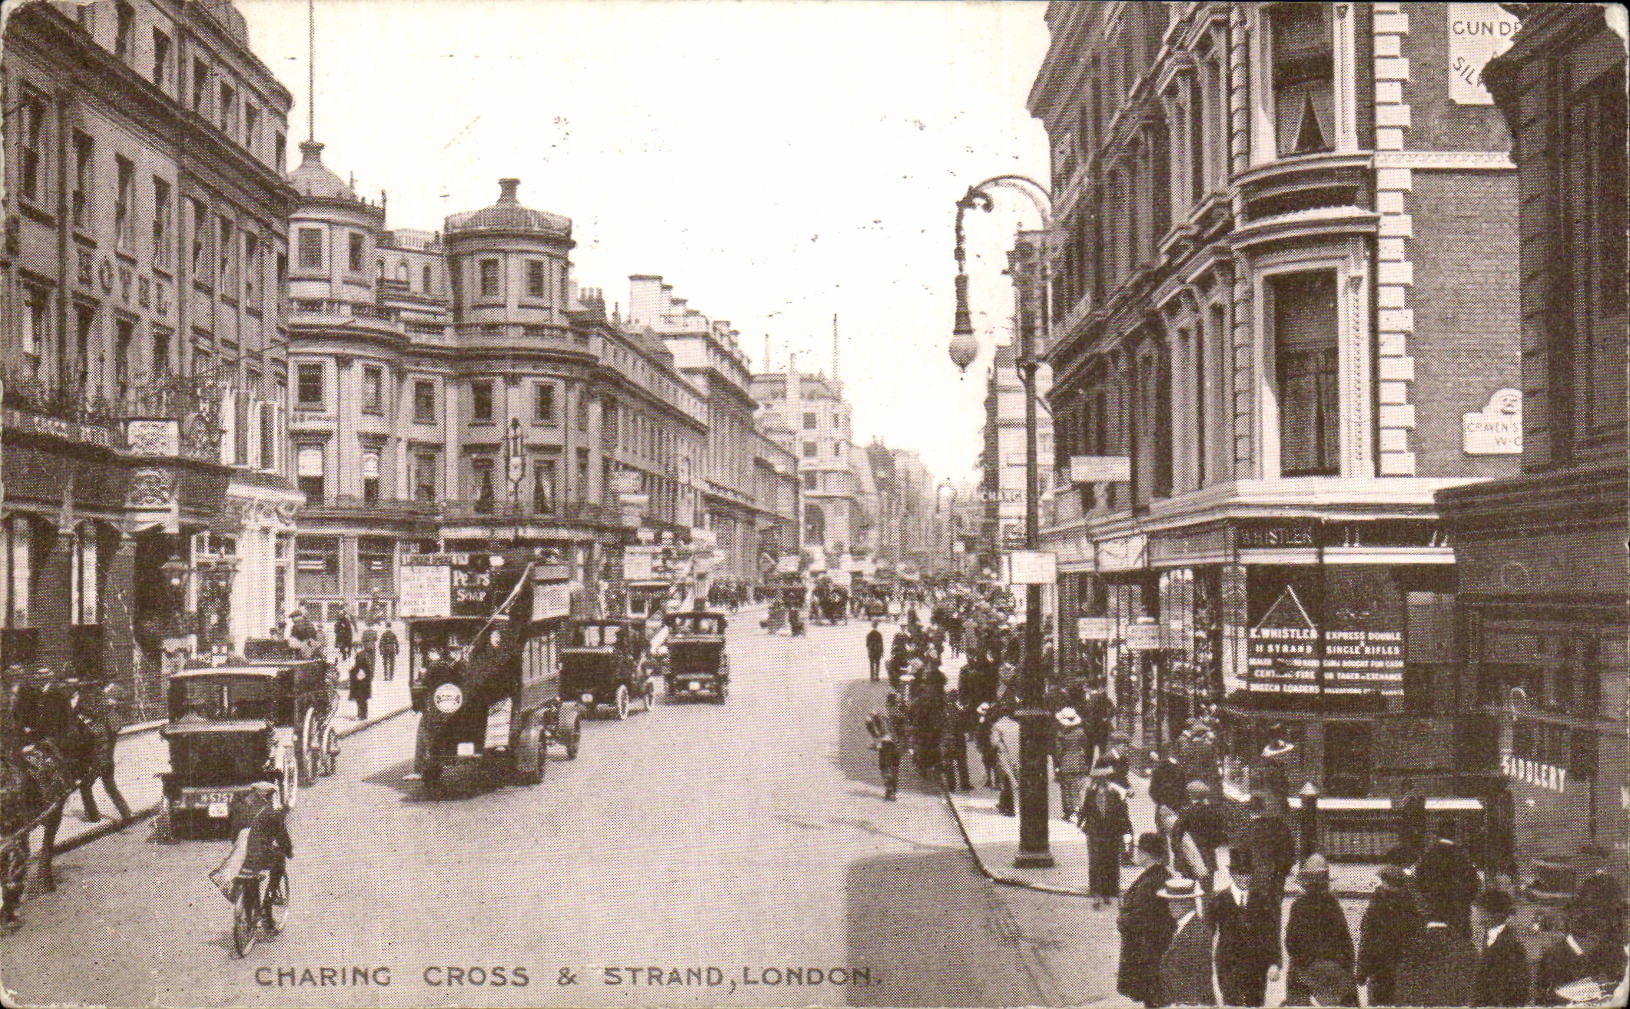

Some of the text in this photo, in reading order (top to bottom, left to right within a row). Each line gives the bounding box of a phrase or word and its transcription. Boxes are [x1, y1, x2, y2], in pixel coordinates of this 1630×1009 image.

[1452, 20, 1493, 36] GUN
[1267, 643, 1312, 654] STRAND
[1326, 645, 1400, 655] SINGLE RIFLES
[1500, 754, 1567, 793] SADDLERY
